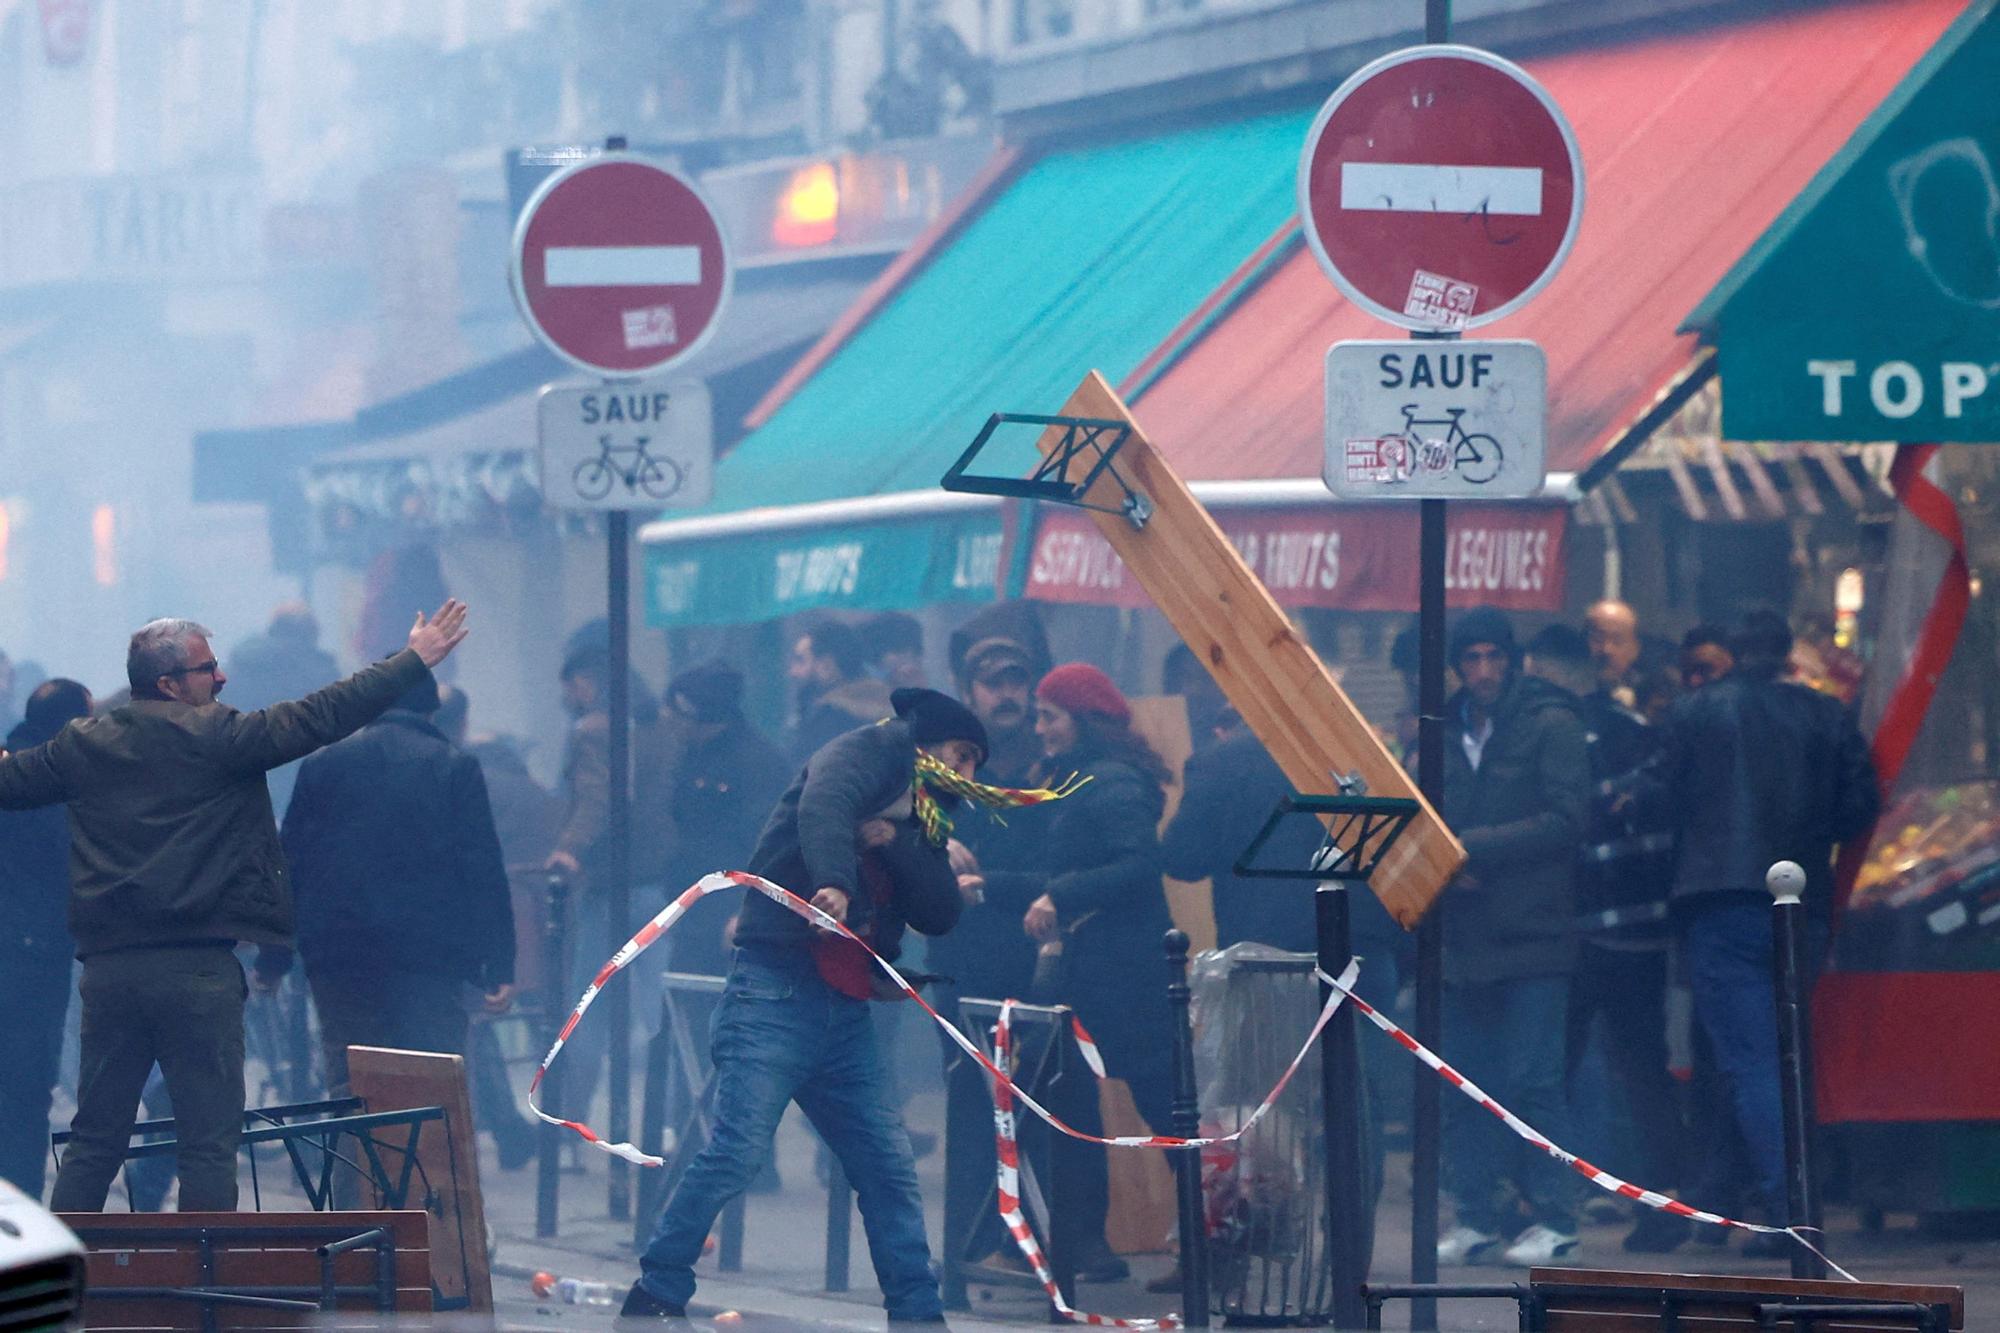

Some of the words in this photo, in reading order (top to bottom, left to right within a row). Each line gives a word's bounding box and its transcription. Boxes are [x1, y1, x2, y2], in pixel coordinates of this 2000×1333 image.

[1379, 353, 1493, 389] SAUF
[1807, 360, 1988, 419] TOP
[580, 393, 670, 424] SAUF
